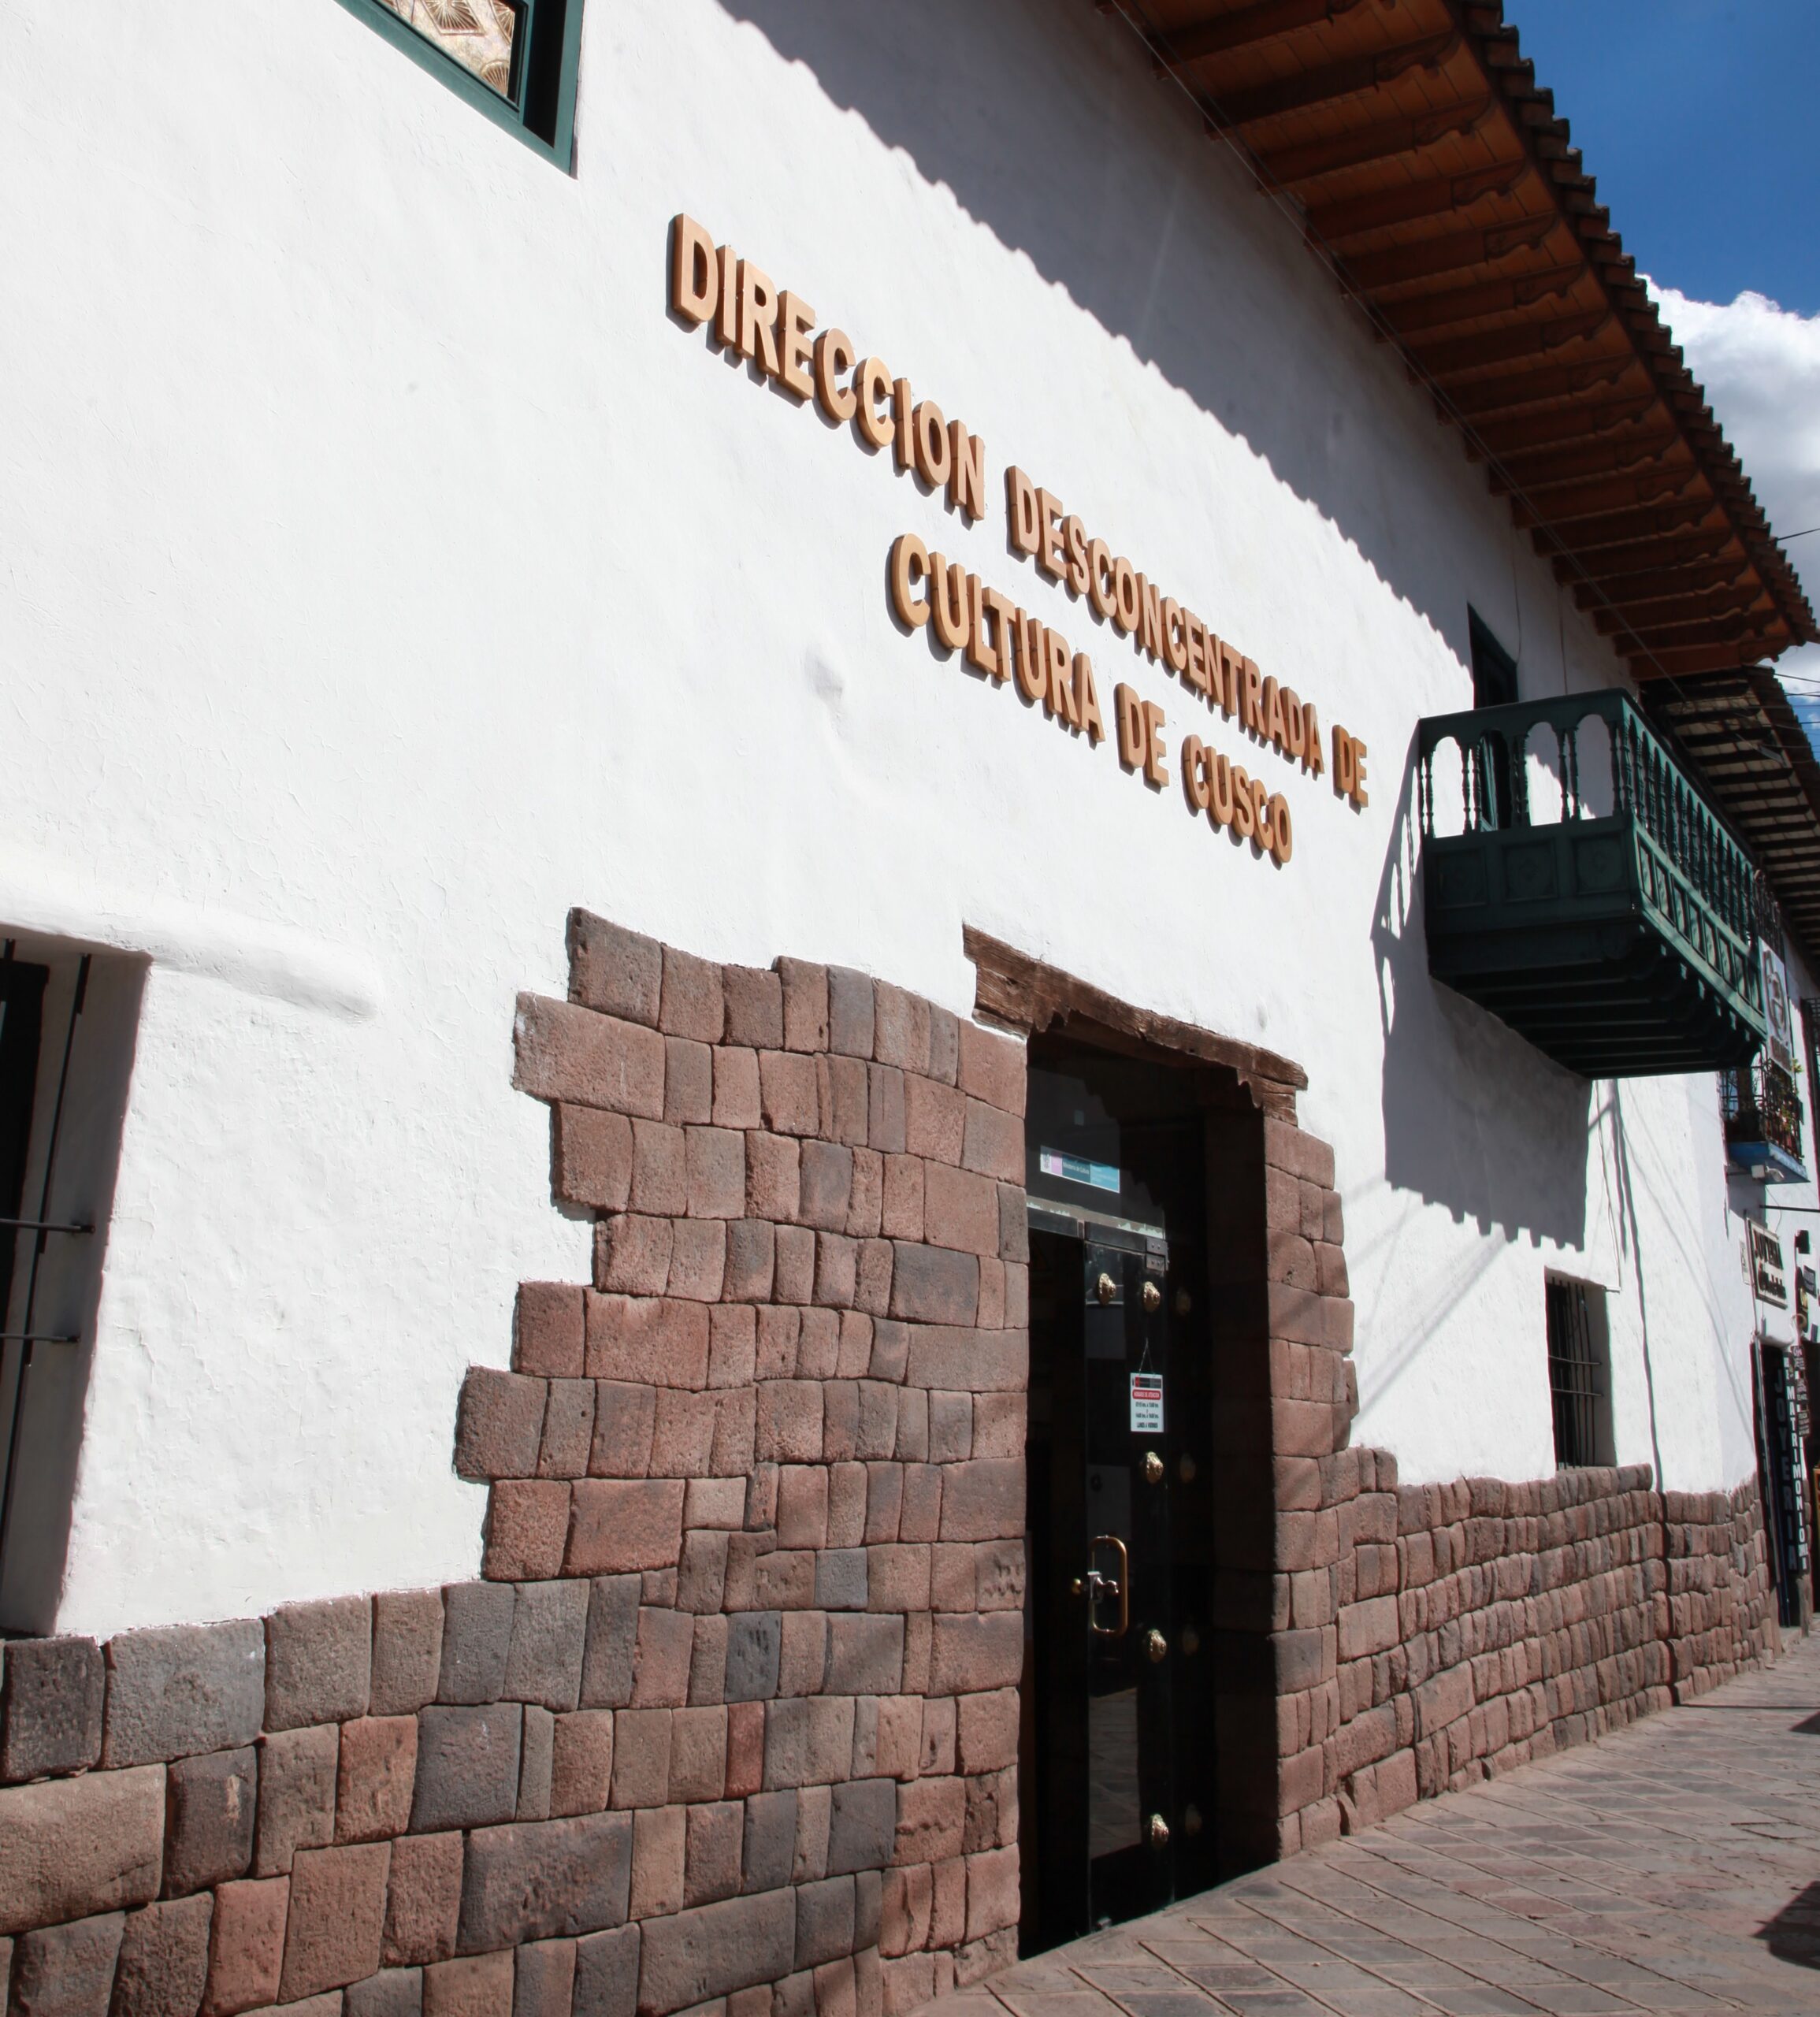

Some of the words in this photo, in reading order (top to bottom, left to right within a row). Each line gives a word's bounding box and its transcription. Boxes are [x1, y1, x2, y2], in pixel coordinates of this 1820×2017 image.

[671, 213, 984, 520] DIRECCION
[1006, 466, 1324, 774] DESCONCENTRADA
[1332, 724, 1368, 808] DE
[890, 533, 1105, 743] CULTURA
[1115, 682, 1168, 788] DE
[1182, 734, 1293, 864] CUSCO
